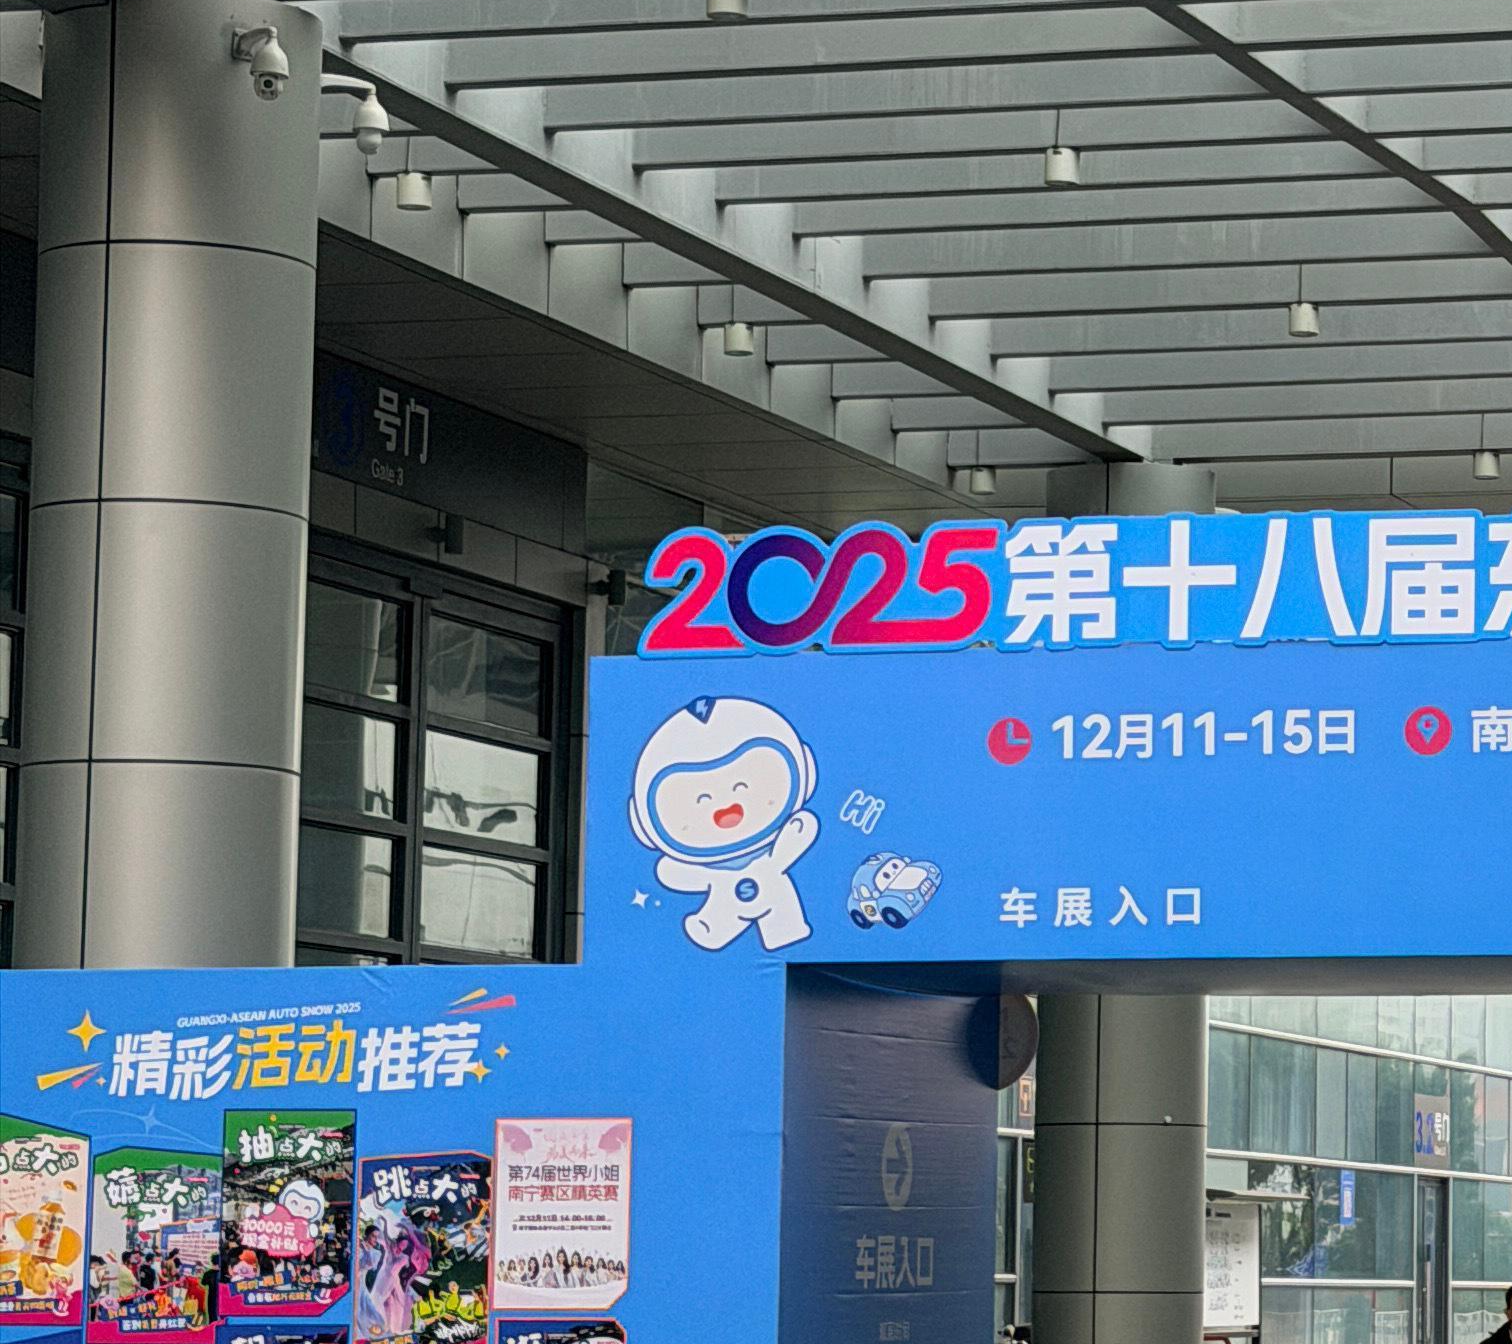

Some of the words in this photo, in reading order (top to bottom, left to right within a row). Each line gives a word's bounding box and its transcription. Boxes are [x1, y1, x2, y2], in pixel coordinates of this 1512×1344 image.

[1052, 708, 1356, 761] 12月11-15日
[839, 789, 886, 835] Hi
[999, 885, 1202, 927] 车展入口
[268, 1006, 300, 1021] AUTO
[335, 1001, 361, 1014] 2025
[108, 1019, 482, 1101] 精彩活动推荐
[508, 1164, 620, 1183] 第74届世界小姐
[855, 1234, 934, 1289] 车展入口
